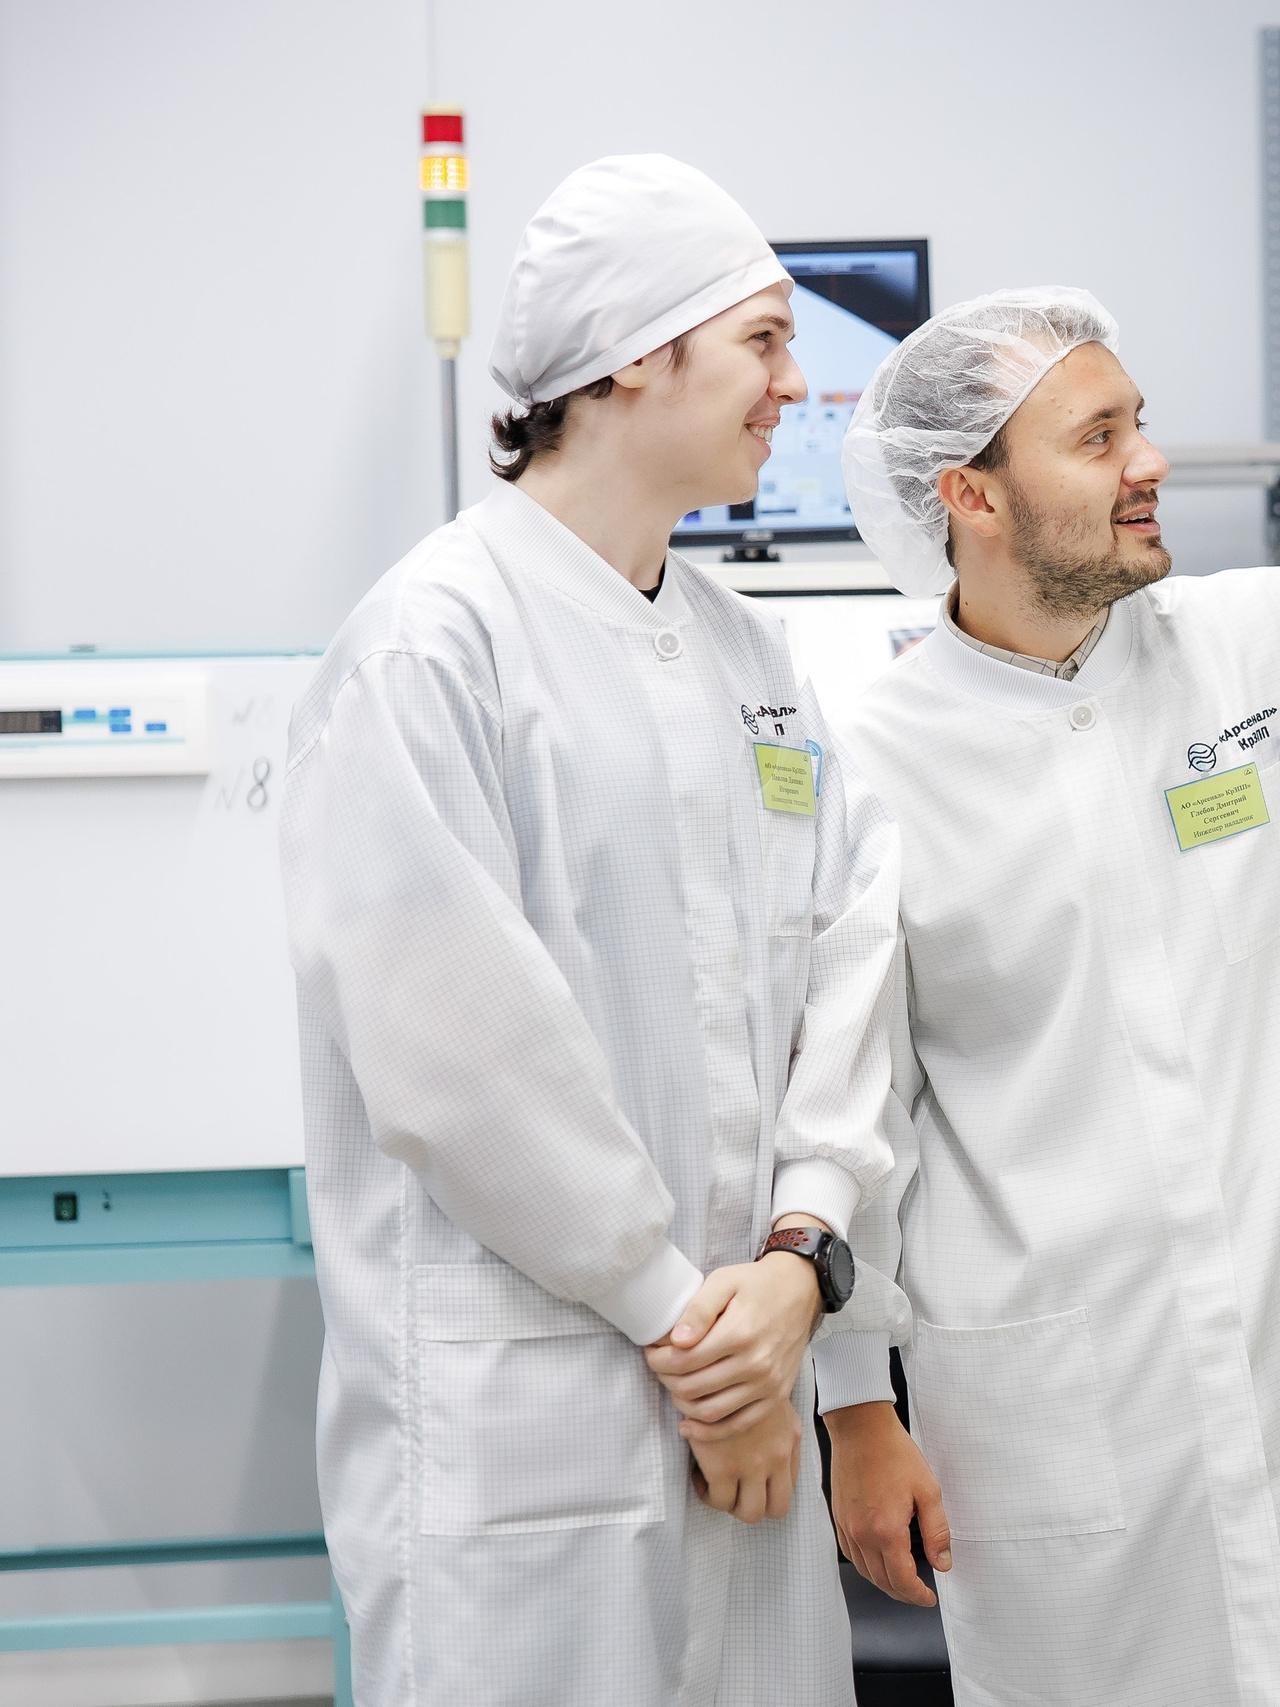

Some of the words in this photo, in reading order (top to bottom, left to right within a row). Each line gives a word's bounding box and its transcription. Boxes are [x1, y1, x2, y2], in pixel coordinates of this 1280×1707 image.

[1218, 706, 1278, 743] «Арсенал»
[1238, 725, 1271, 751] КрЗПП
[1180, 801, 1192, 811] АО
[1192, 790, 1225, 807] «Арсенал»
[1225, 782, 1252, 797] КрЗПП»
[1190, 805, 1215, 818] Глебов
[1216, 794, 1247, 813] Дмитрий
[1203, 808, 1240, 825] Сергеевич
[1193, 824, 1224, 839] Инженер
